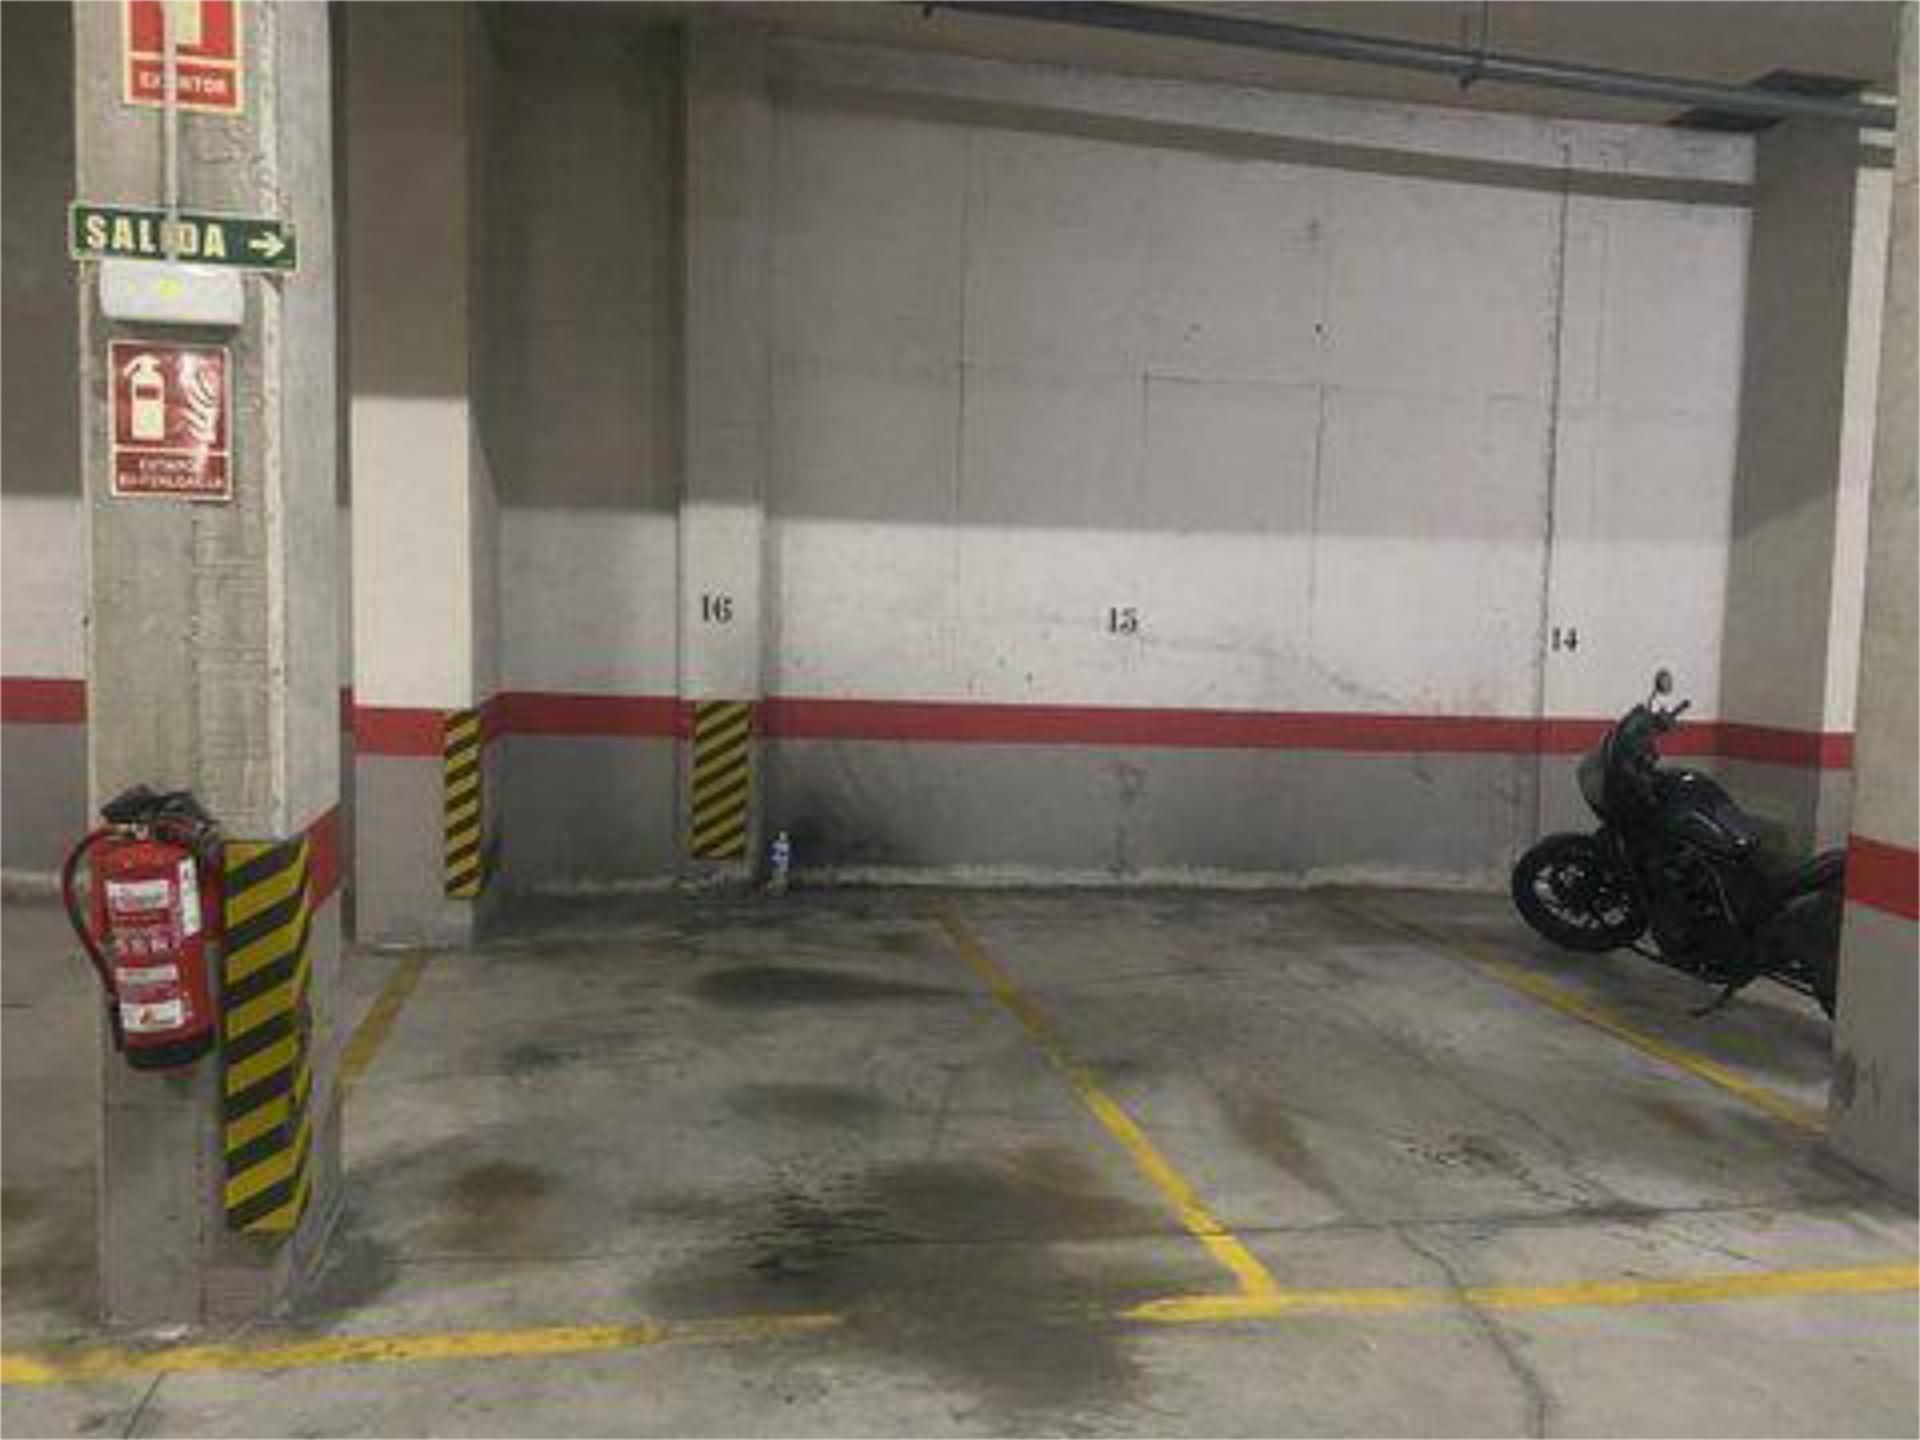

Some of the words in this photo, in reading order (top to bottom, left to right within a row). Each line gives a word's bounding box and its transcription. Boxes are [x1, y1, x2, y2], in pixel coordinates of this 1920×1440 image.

[86, 213, 226, 258] SALDA
[702, 594, 733, 624] 16
[1109, 606, 1138, 637] 15
[1552, 626, 1580, 652] 14
